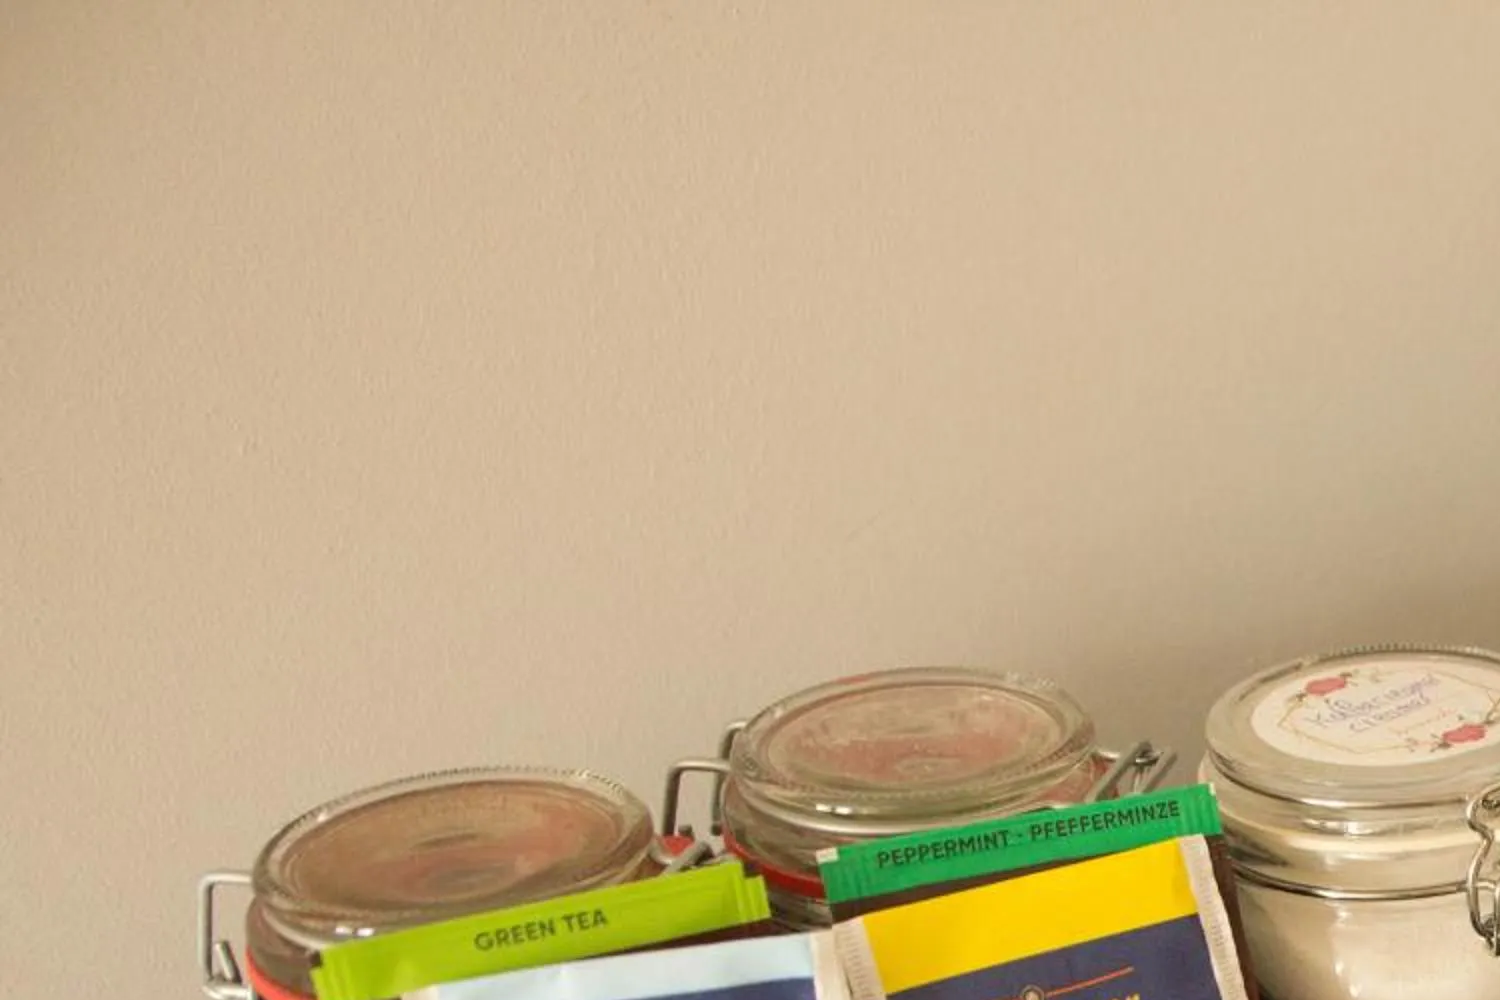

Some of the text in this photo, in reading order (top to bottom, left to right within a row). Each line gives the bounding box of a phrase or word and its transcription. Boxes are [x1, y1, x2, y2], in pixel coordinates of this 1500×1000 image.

[876, 829, 1010, 870] PEPPERMINT
[1029, 800, 1180, 842] PFEFFERMINZE
[473, 908, 608, 951] GREEN TEA
